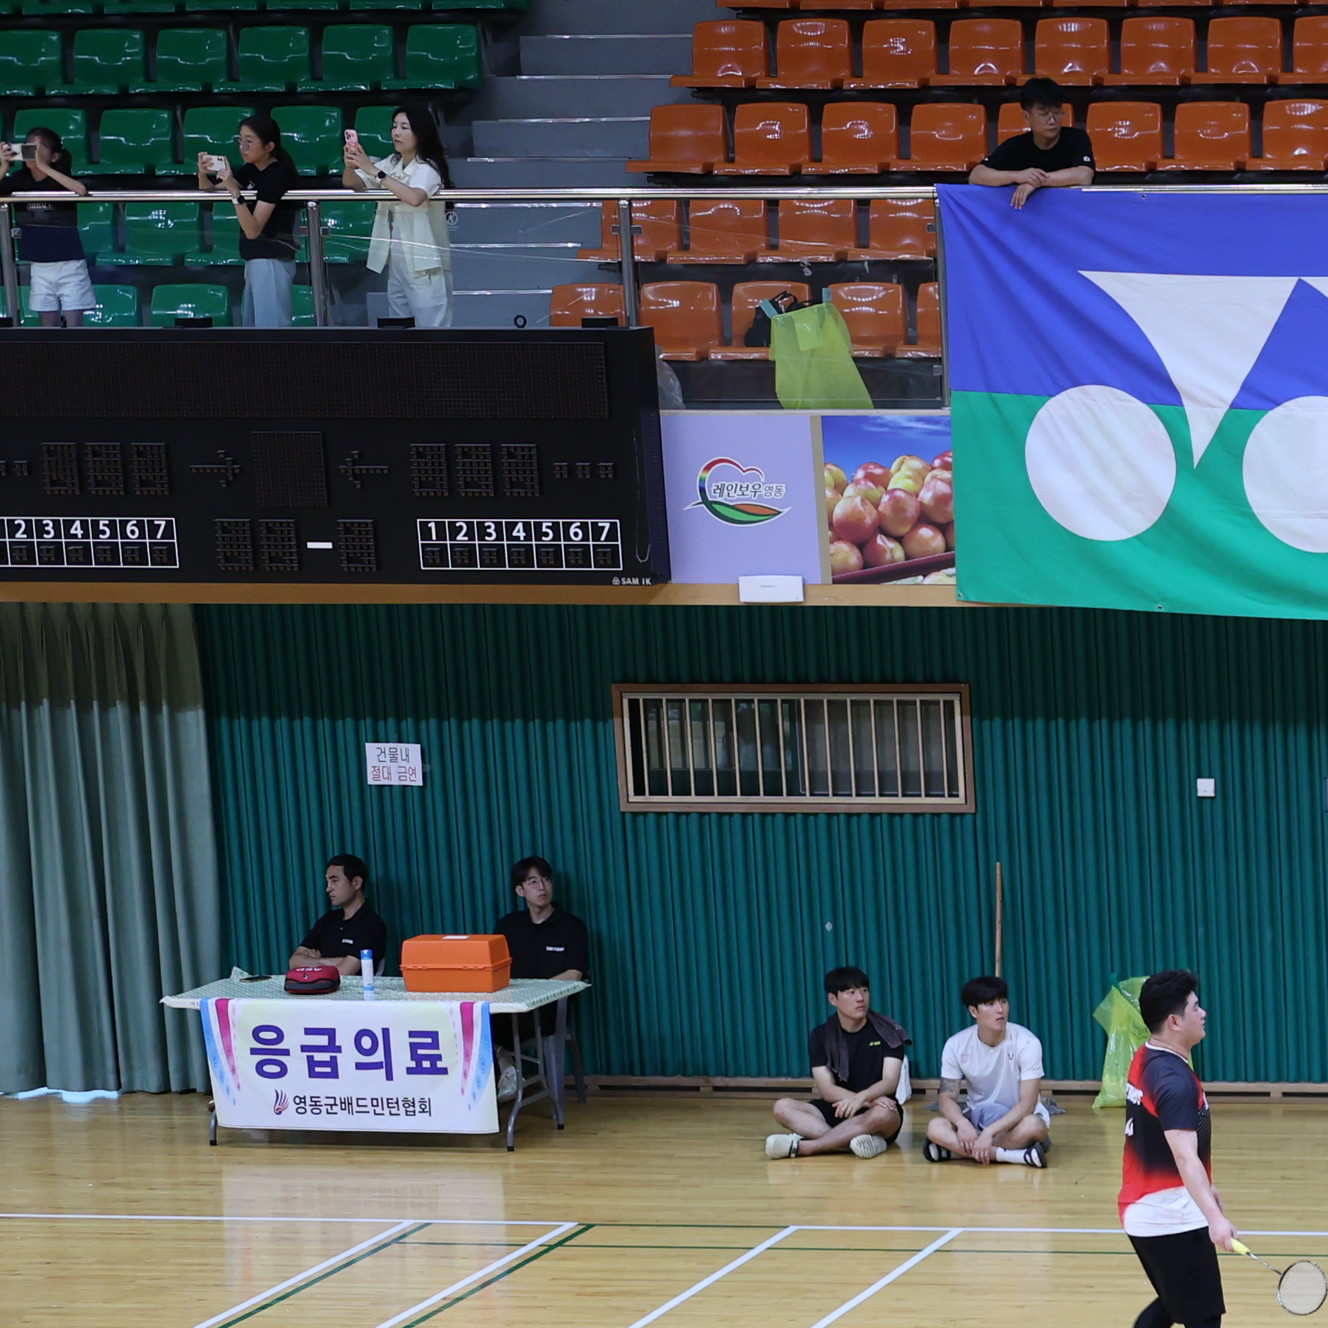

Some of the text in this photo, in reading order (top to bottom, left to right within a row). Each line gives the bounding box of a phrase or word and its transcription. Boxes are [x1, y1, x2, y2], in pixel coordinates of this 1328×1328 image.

[712, 482, 785, 498] 레인보우 영동
[14, 520, 166, 539] 2 3 4 5 6 7
[427, 522, 610, 541] 1 2 3 4 5 6 7
[621, 577, 652, 586] SAM IK
[376, 746, 410, 764] 건물내
[371, 765, 417, 782] 절대 금연
[250, 1024, 449, 1081] 응급의료
[293, 1095, 432, 1117] 영동군배드민턴협회
